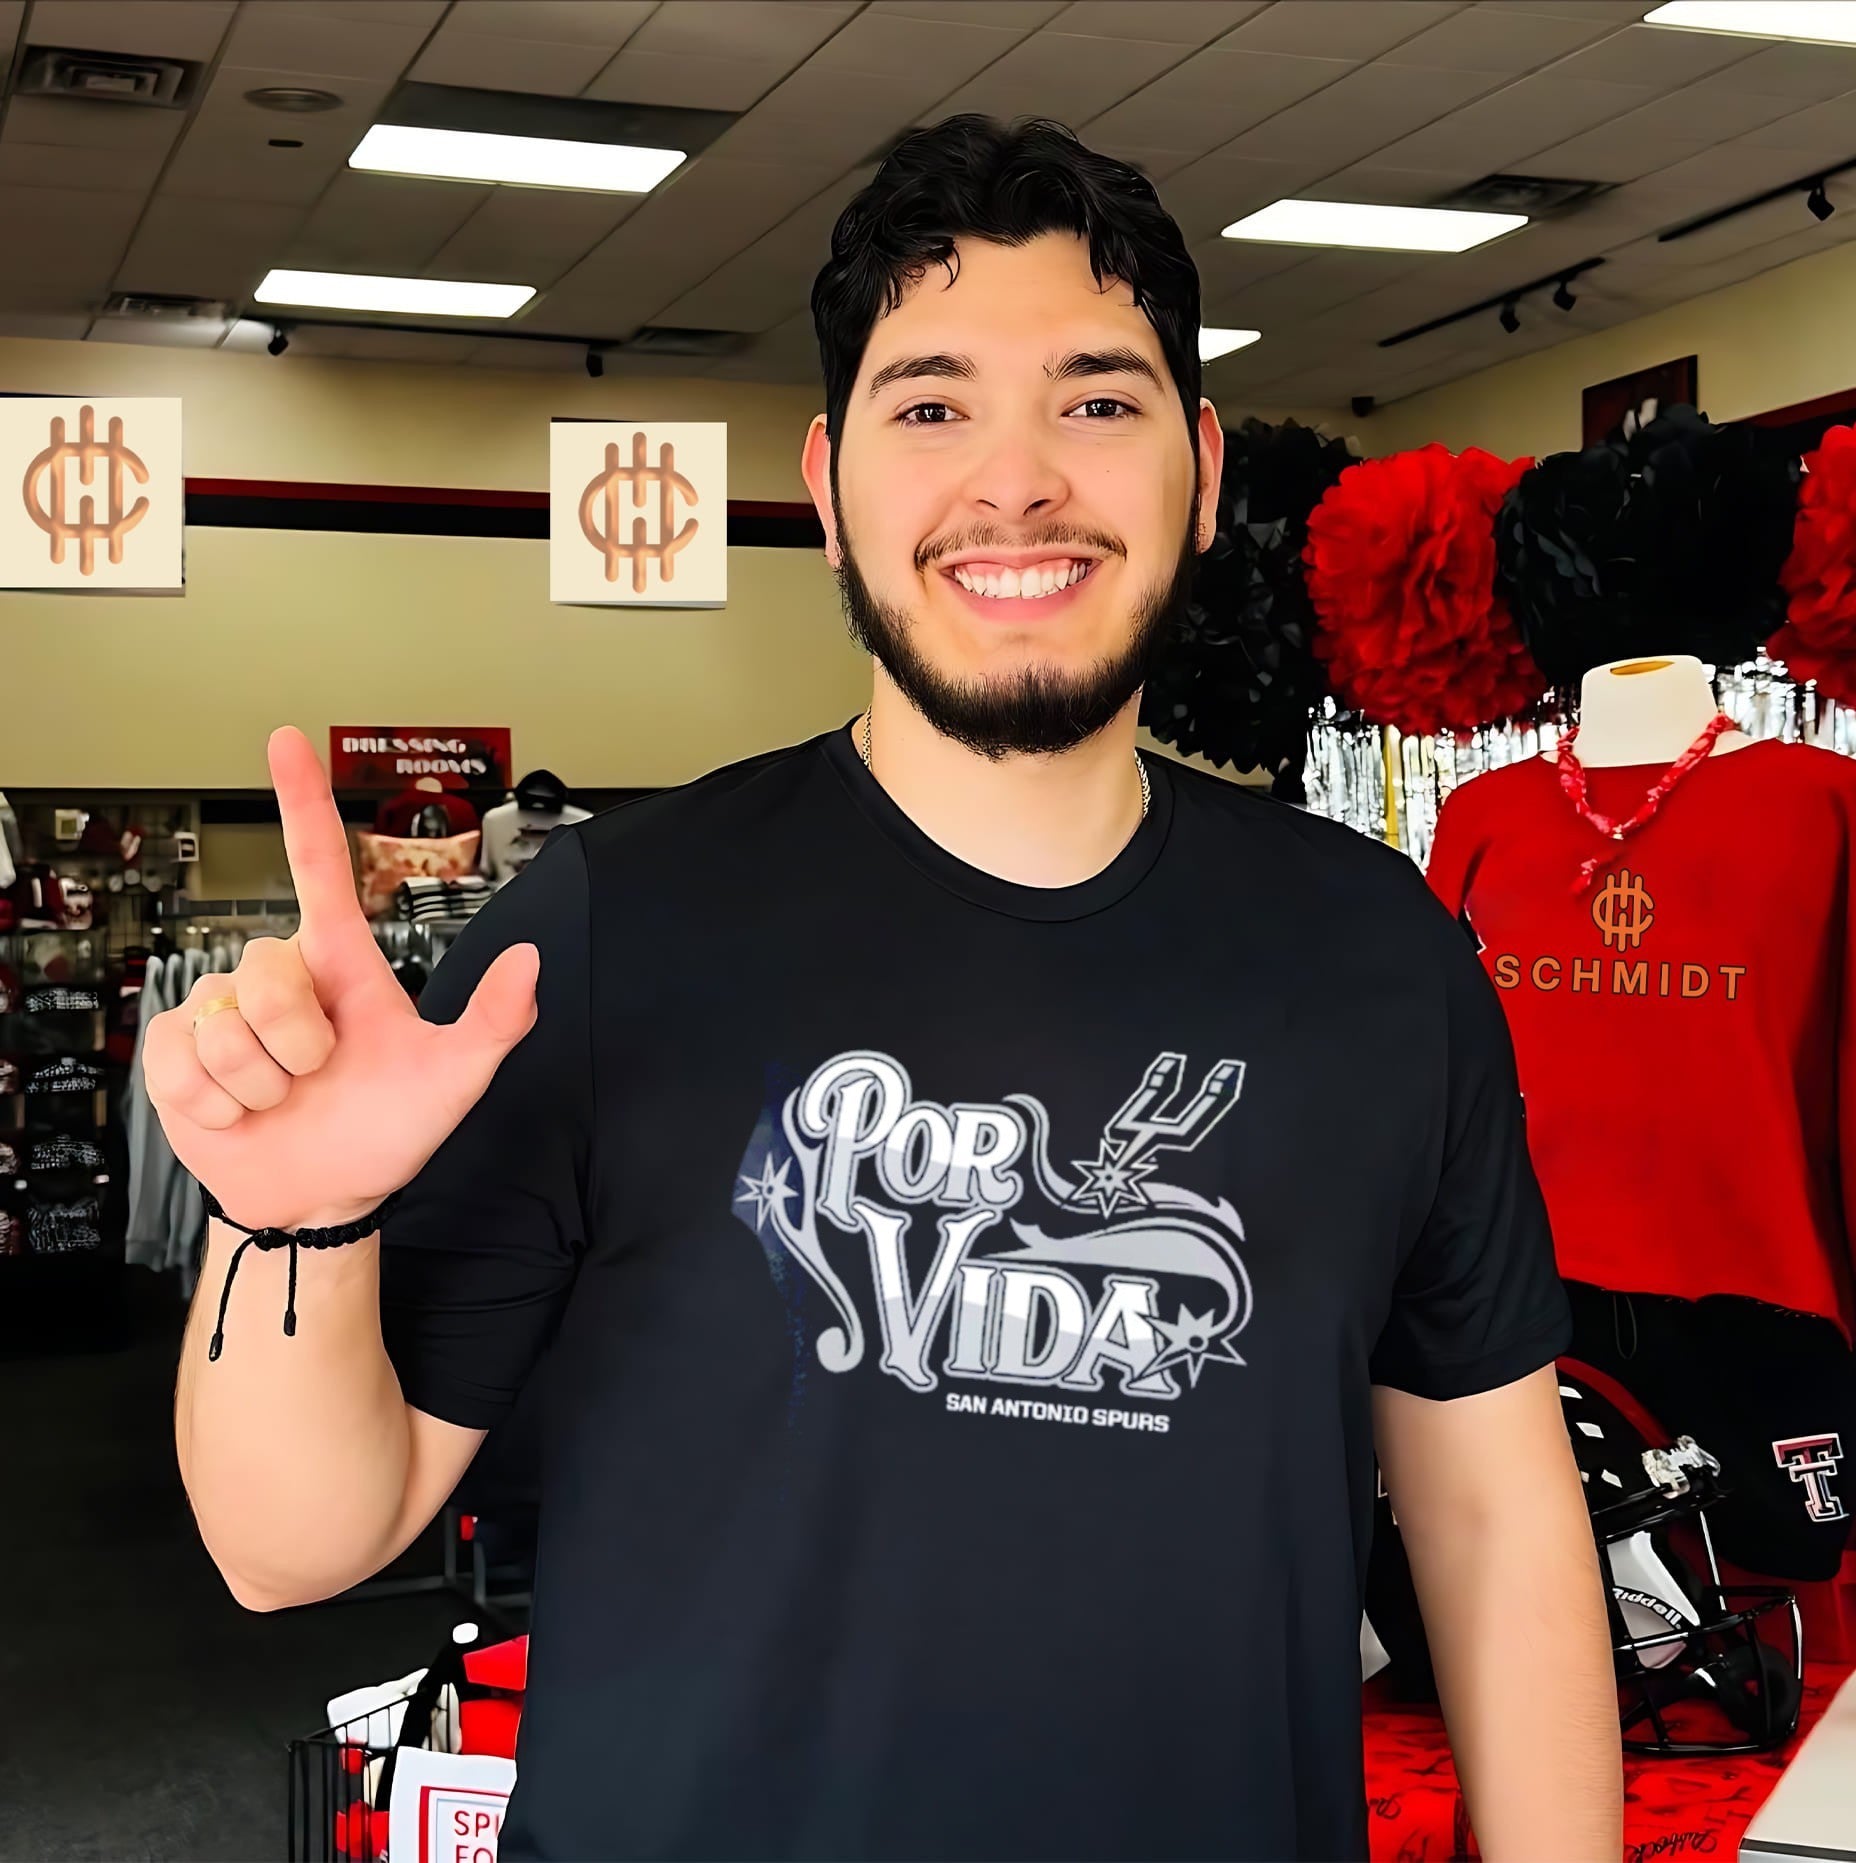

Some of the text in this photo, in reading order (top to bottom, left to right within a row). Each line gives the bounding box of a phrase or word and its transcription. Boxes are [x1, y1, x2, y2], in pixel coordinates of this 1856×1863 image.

[396, 758, 487, 774] ROOMS
[1494, 955, 1746, 1000] SCHMIDT
[852, 1202, 1181, 1400] VIDA
[946, 1393, 1171, 1433] SAN ANTONIO SPURS
